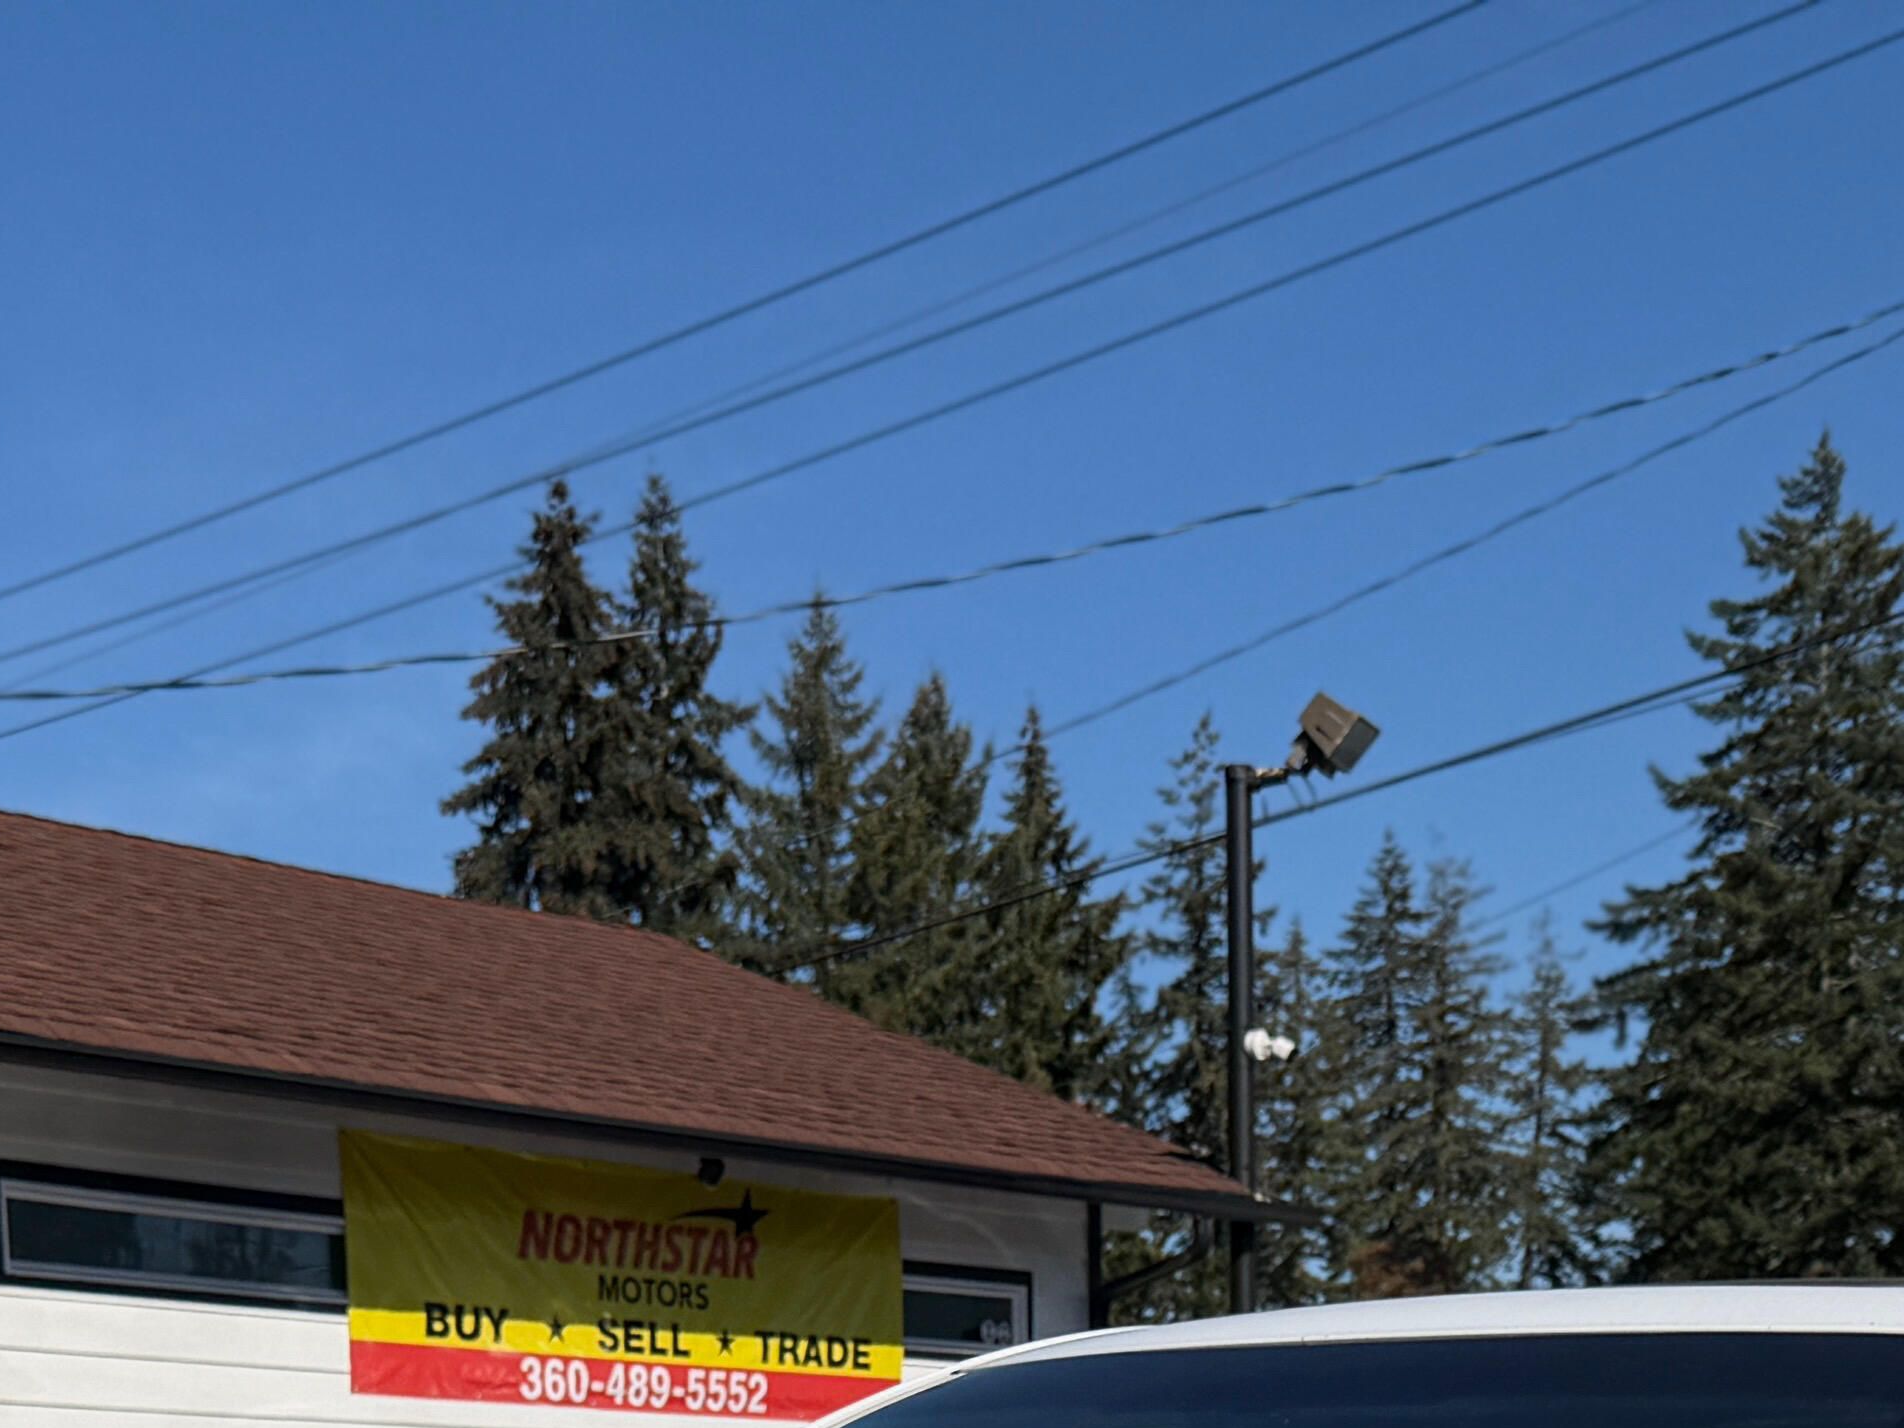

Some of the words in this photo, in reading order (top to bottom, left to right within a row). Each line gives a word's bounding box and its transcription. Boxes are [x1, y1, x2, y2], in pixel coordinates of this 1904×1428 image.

[517, 1208, 759, 1280] NORTHSTAR
[598, 1274, 710, 1311] MOTORS
[424, 1301, 509, 1343] BUY
[597, 1317, 691, 1359] SELL
[754, 1329, 873, 1371] TRADE
[519, 1356, 769, 1414] 360-489-5552
